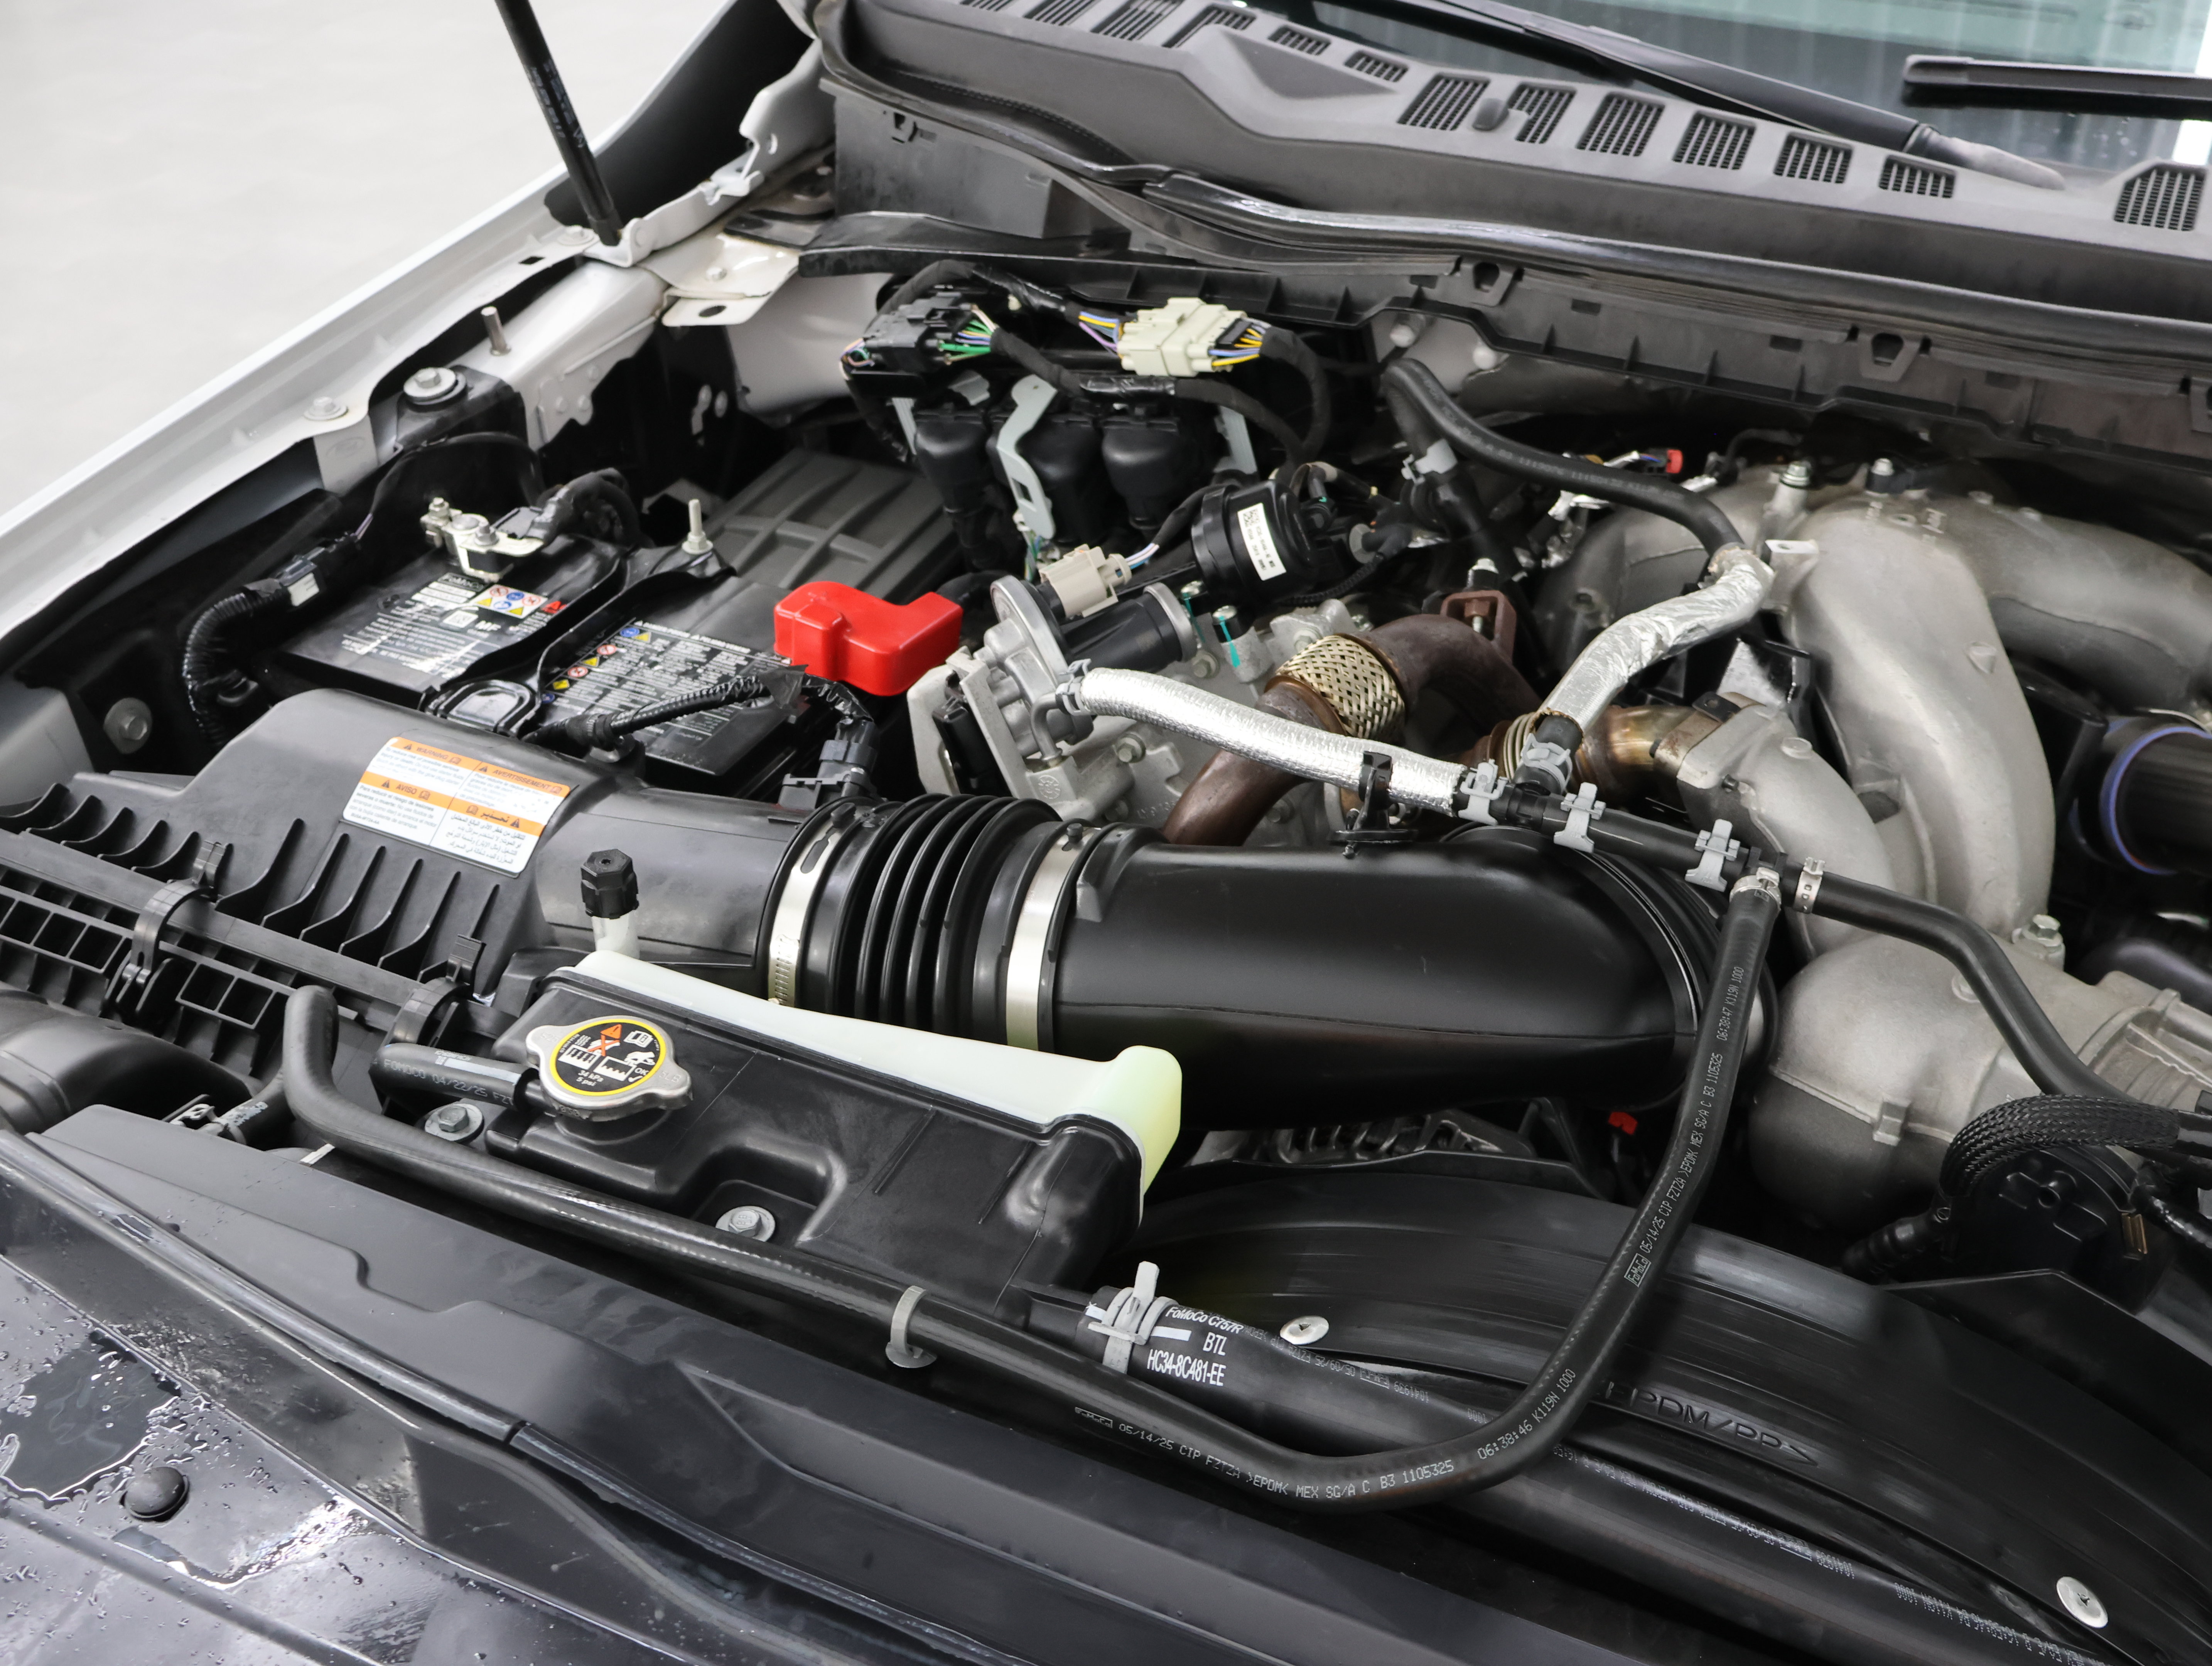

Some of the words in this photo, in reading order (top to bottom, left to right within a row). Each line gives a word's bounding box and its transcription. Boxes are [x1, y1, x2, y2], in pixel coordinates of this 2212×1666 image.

[417, 747, 449, 759] WARNING
[396, 784, 417, 794] AVISO
[493, 769, 551, 789] AVERTISSEMENT
[374, 811, 390, 820] caliente
[413, 809, 427, 817] fluidos
[415, 803, 434, 811] lesiones
[1731, 966, 1744, 983] 1000
[1724, 984, 1739, 1006] K119N
[1716, 1007, 1733, 1041] 06:38:47
[588, 1072, 604, 1082] kPa
[1706, 1052, 1723, 1083] 1105325
[432, 1074, 488, 1097] 04/22/25
[581, 1079, 597, 1087] psi
[1703, 1085, 1715, 1097] B3
[1694, 1109, 1709, 1129] SG/A
[1690, 1130, 1703, 1147] MEX
[1666, 1177, 1686, 1201] FZTZA
[1659, 1201, 1672, 1216] CIP
[1640, 1216, 1665, 1253] 05/14/25
[1625, 1255, 1650, 1286] FoMoCo
[1166, 1307, 1208, 1322] FoMoCo
[1208, 1316, 1244, 1334] C757R
[1203, 1332, 1227, 1356] BTL
[1147, 1349, 1227, 1386] HC34-8C481-EE
[1477, 1420, 1532, 1459] 06:38:46
[1532, 1391, 1560, 1422] K119N
[1556, 1369, 1576, 1392] 1000
[1119, 1423, 1174, 1450] 05/14/25
[1179, 1445, 1201, 1459] CIP
[1296, 1485, 1318, 1499] MEX
[1326, 1483, 1356, 1498] SG/A
[1362, 1480, 1370, 1493] C
[1380, 1474, 1395, 1489] B3
[1403, 1460, 1454, 1483] 1105325
